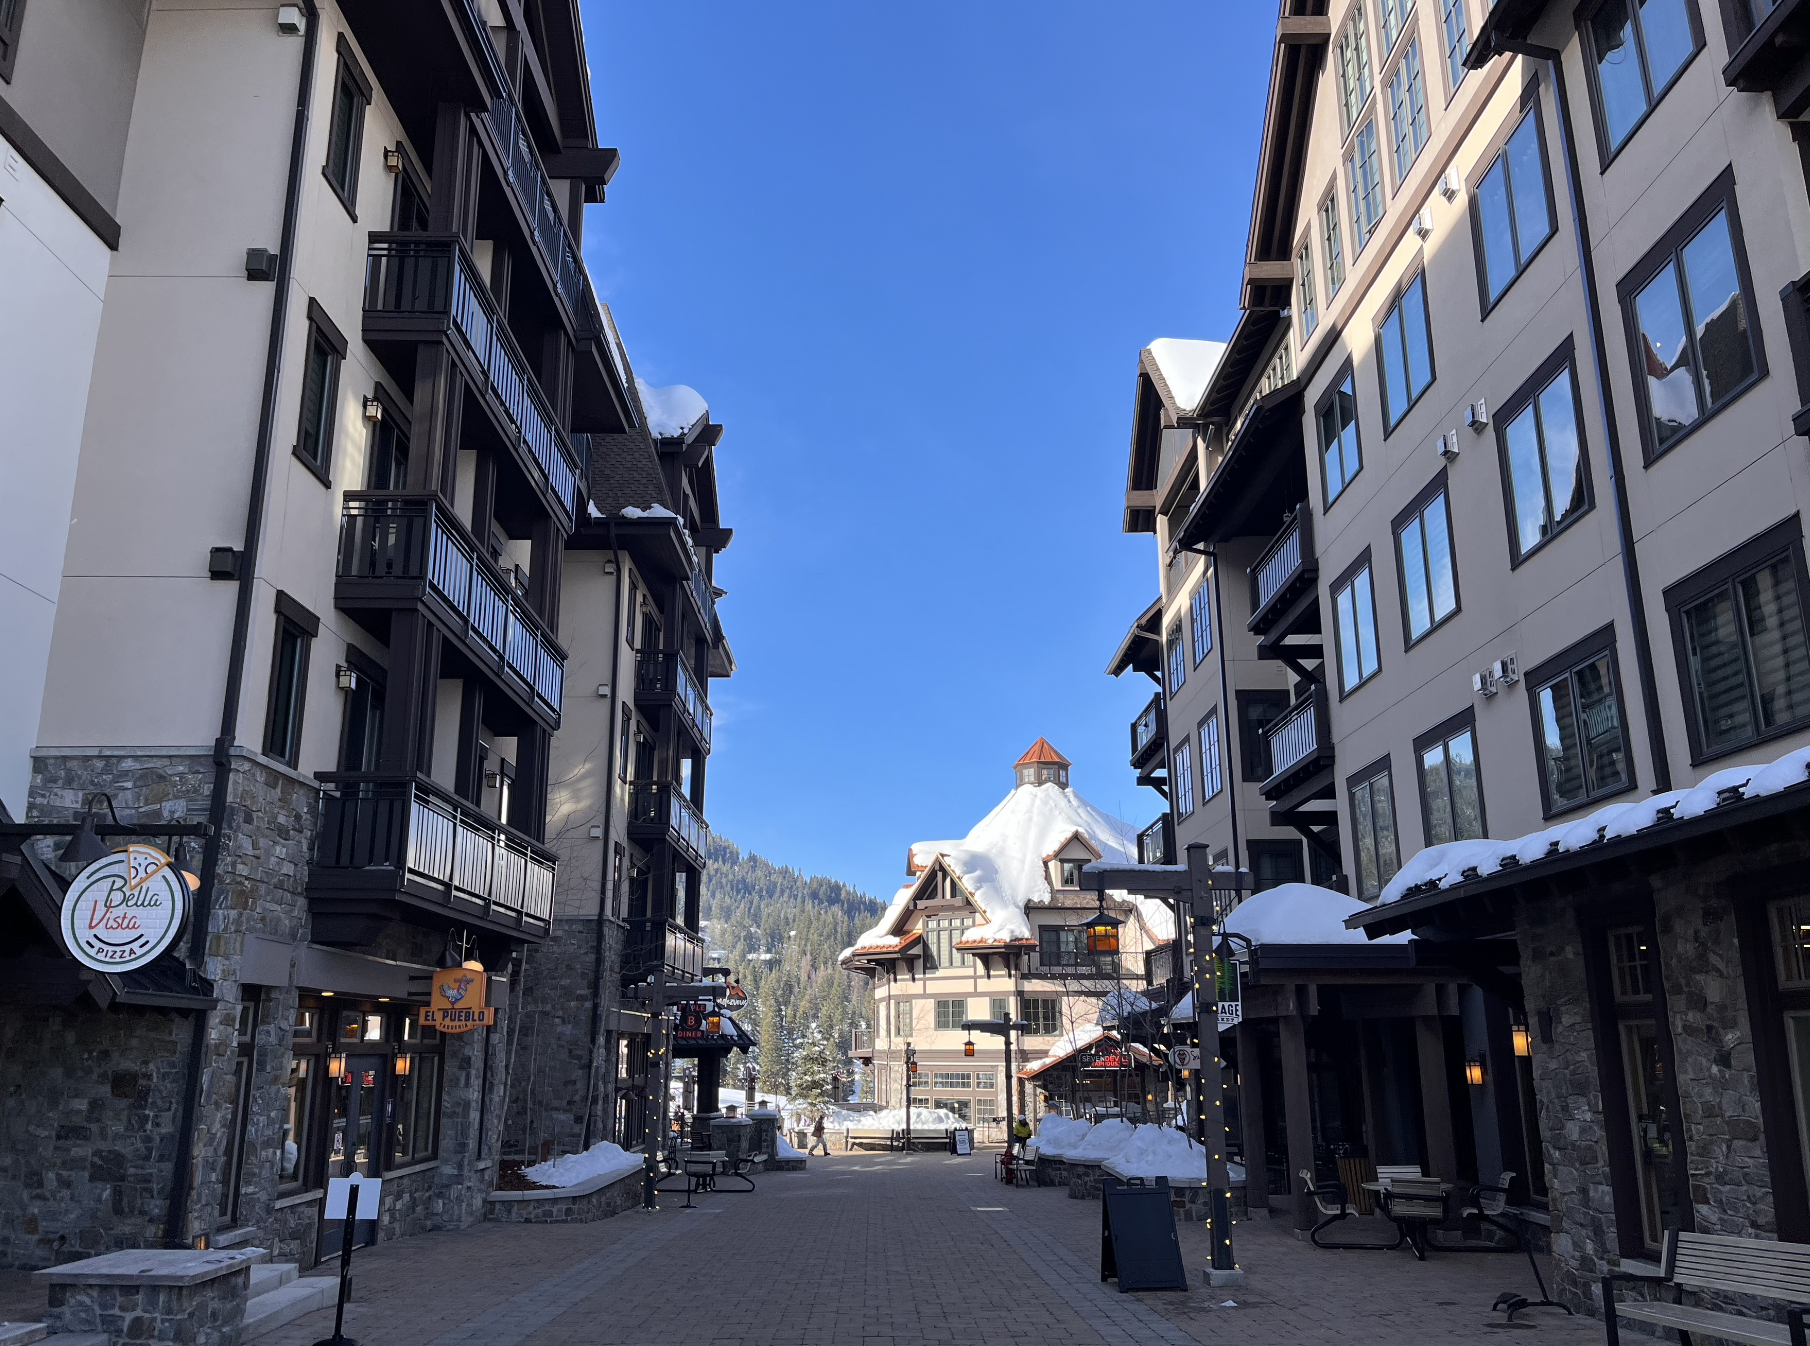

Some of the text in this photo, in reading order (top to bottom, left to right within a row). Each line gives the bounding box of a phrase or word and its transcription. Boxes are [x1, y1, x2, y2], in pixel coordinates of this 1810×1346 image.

[104, 874, 162, 908] Bella
[89, 898, 141, 930] Vista
[96, 947, 137, 959] PIZZA
[424, 1010, 484, 1021] EL PUEBLO
[1218, 1004, 1240, 1017] AGE
[688, 1015, 696, 1026] B
[677, 1030, 702, 1038] DINER
